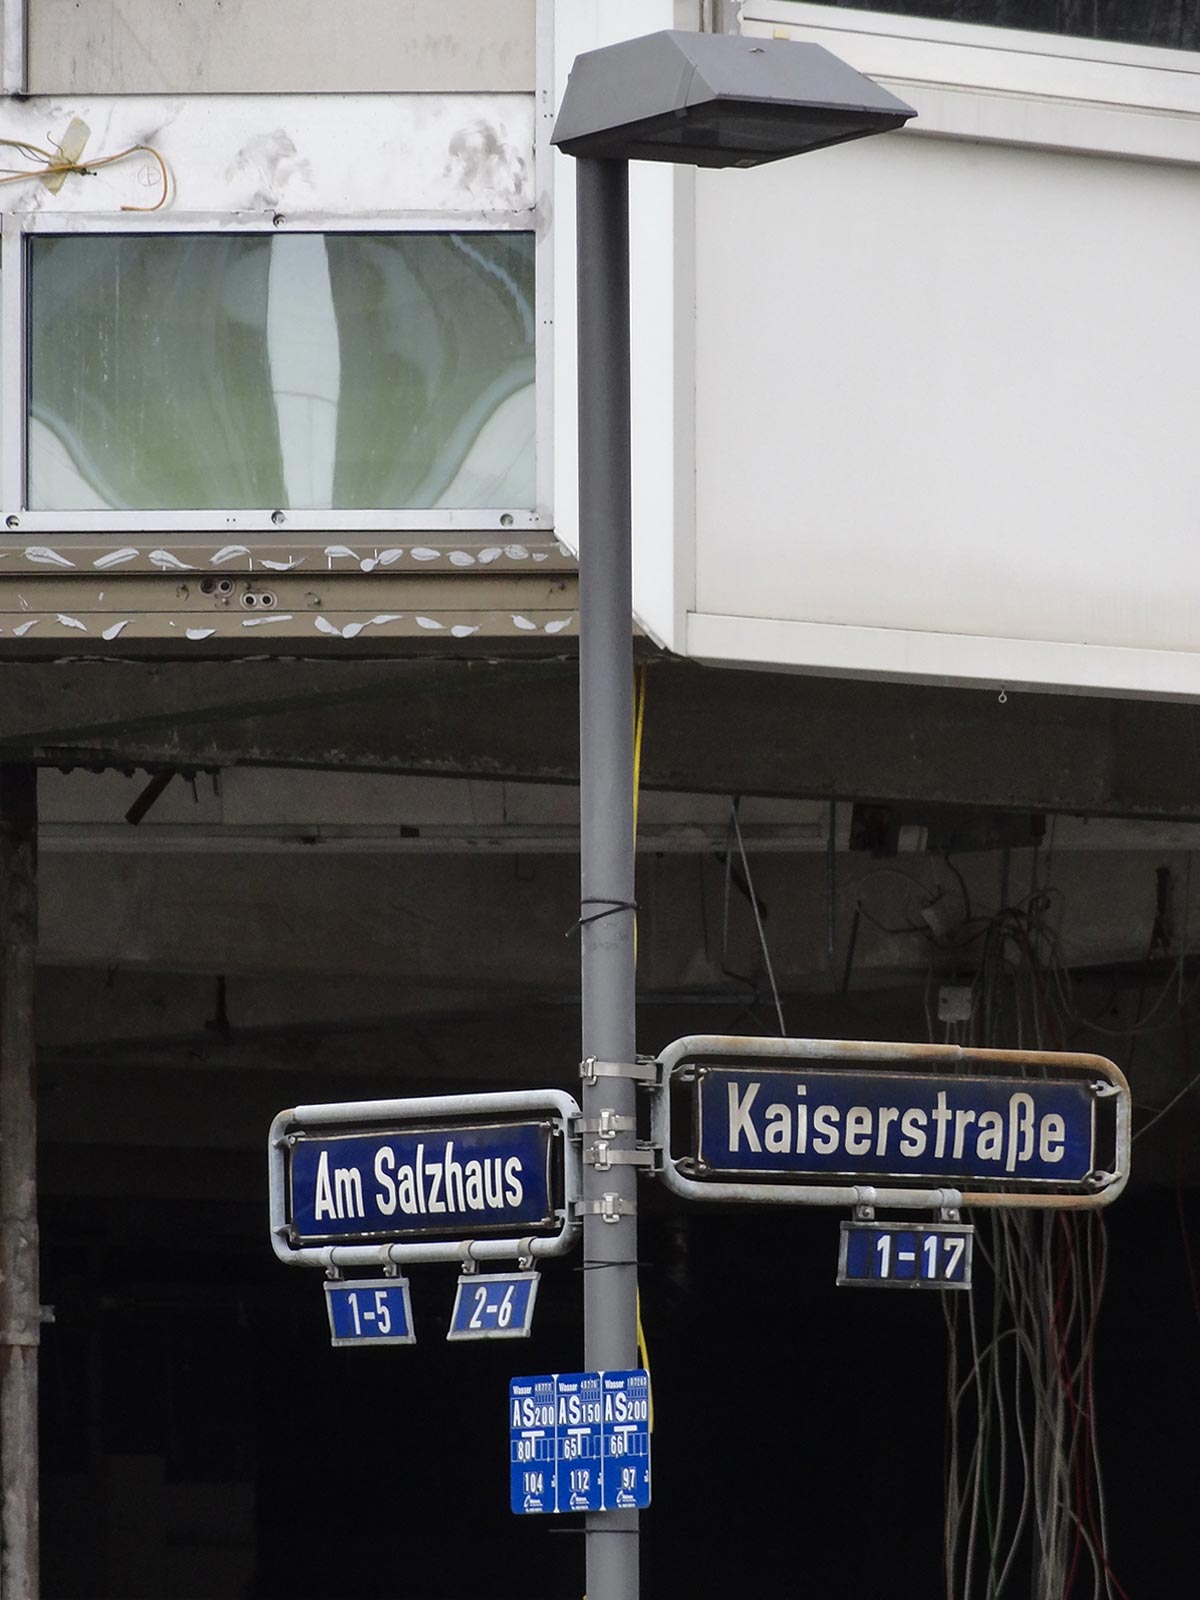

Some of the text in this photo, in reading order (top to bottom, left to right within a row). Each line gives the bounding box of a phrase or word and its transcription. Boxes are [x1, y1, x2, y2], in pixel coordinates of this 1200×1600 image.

[727, 1082, 1066, 1172] Kaiserstraße
[315, 1142, 523, 1220] Am Salzhaus
[876, 1234, 965, 1279] 1-17
[348, 1290, 392, 1335] 1-5
[469, 1285, 515, 1329] 2-6
[513, 1386, 532, 1395] Wasser
[558, 1383, 578, 1392] Wasser
[605, 1380, 624, 1389] Wasser
